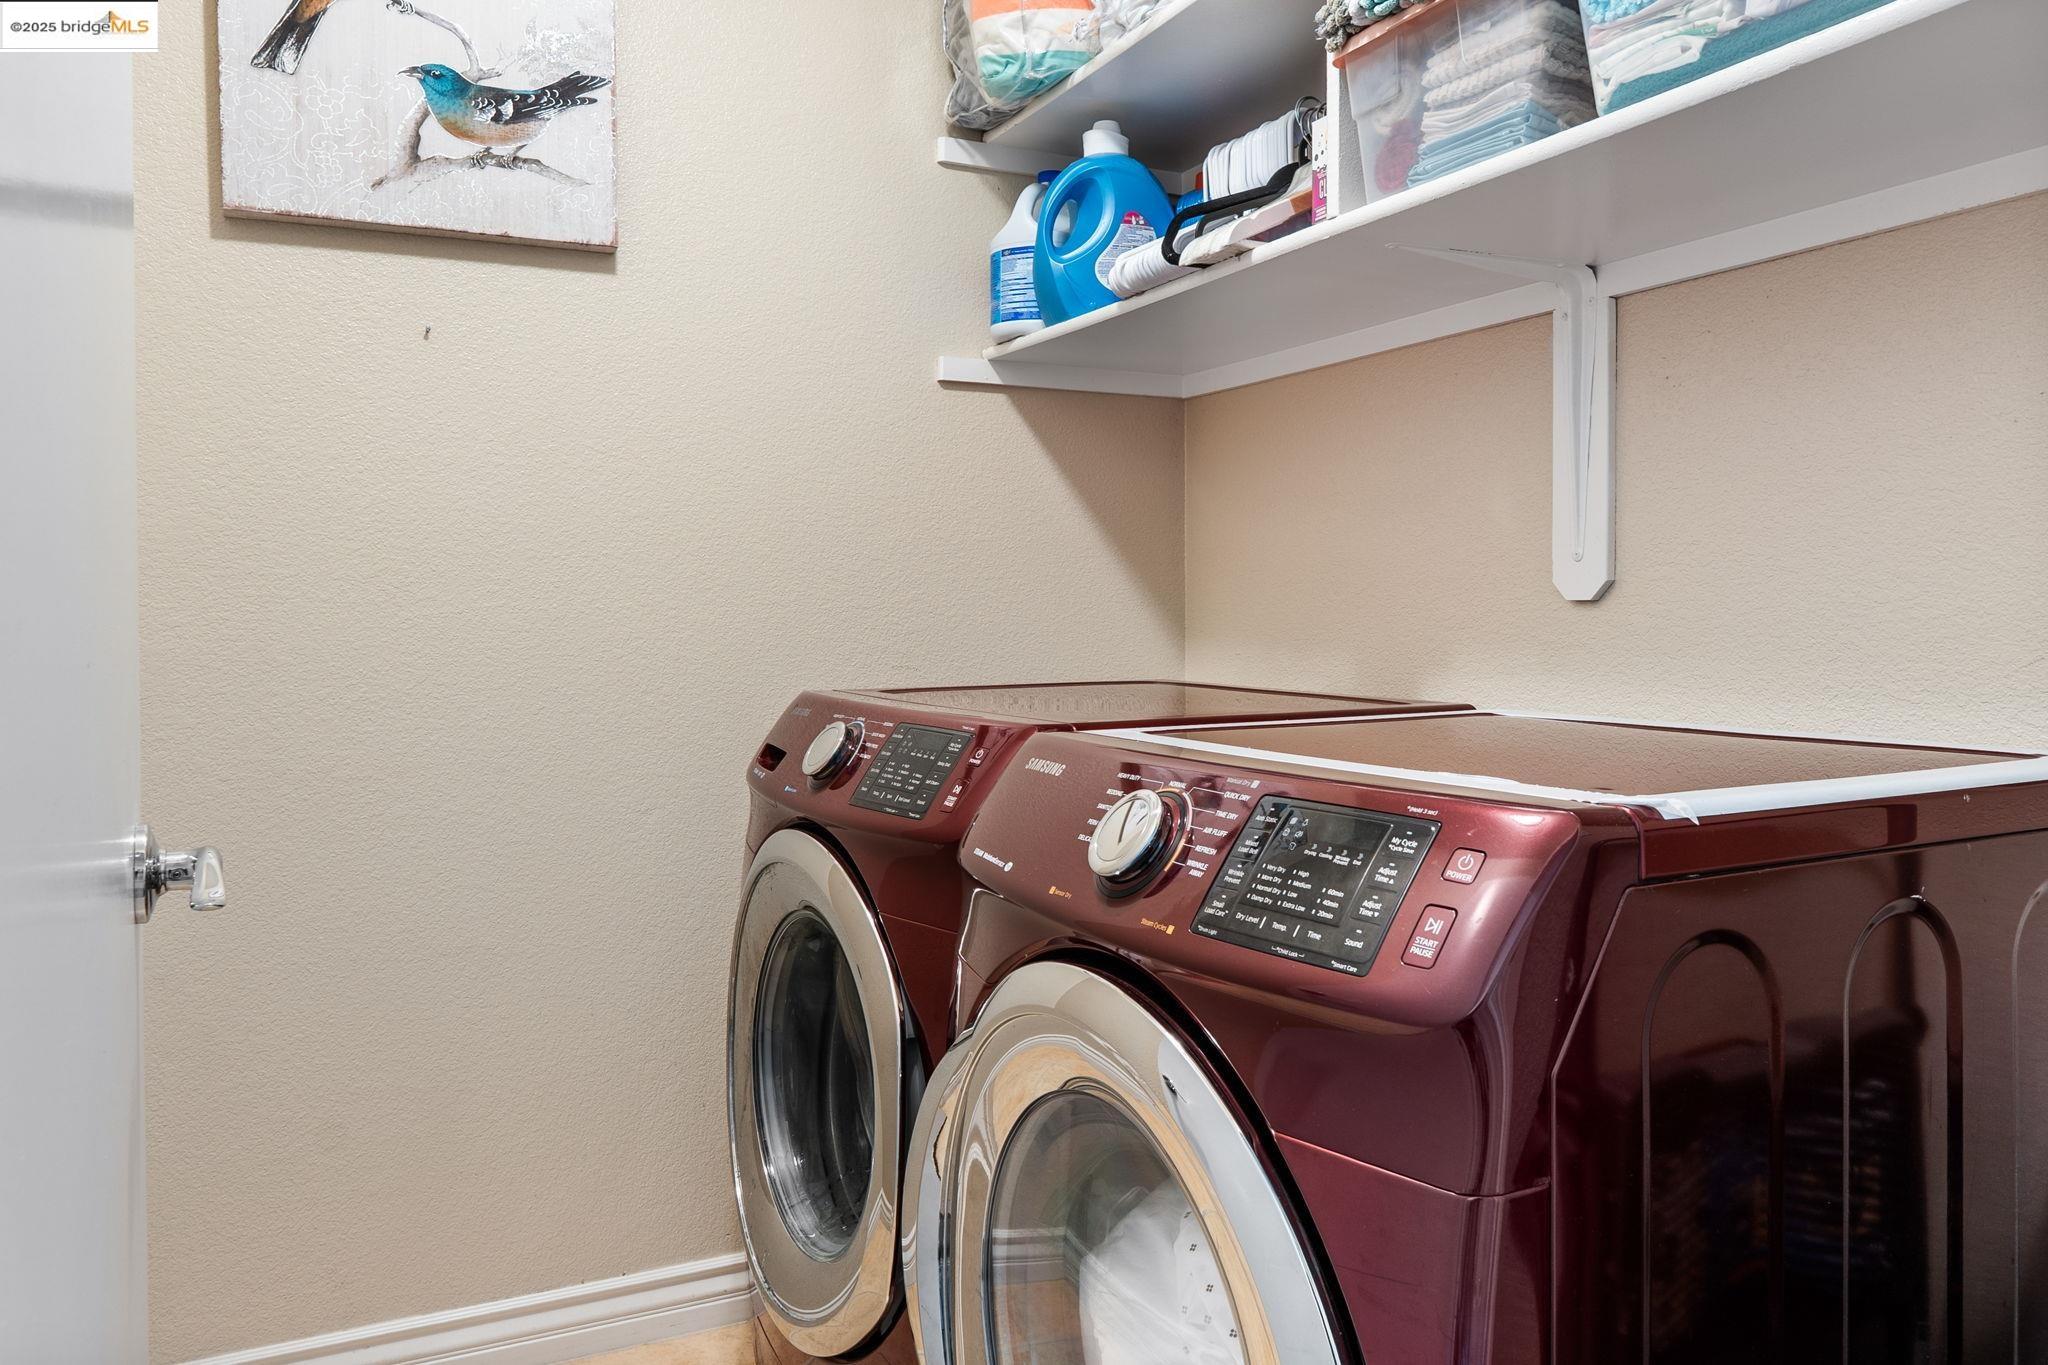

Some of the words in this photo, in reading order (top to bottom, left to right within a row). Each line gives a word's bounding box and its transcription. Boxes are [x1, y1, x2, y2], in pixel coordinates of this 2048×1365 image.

[1025, 758, 1066, 776] SAMSUNG
[1168, 780, 1187, 789] NORMAL
[1224, 791, 1240, 800] QUICK
[1215, 810, 1227, 818] TIME
[1265, 815, 1278, 824] Static
[1212, 829, 1228, 837] FLUFF
[1391, 836, 1402, 845] My
[1401, 838, 1418, 848] Cycle
[1194, 845, 1217, 856] REFRESH
[1187, 860, 1208, 870] WRINKLE
[1266, 863, 1278, 872] Very
[1188, 868, 1205, 878] AWAY
[1378, 866, 1398, 876] Adjust
[1446, 870, 1472, 881] POWER
[1224, 875, 1241, 884] Prevent
[1375, 874, 1389, 883] Time
[1256, 884, 1272, 892] Normal
[1292, 880, 1312, 890] Medium
[1327, 888, 1344, 898] 60min
[1250, 894, 1264, 903] Damp
[1264, 897, 1273, 905] Dry
[1322, 899, 1339, 908] 40min
[1282, 901, 1295, 909] Extra
[1362, 900, 1382, 910] Adjust
[1204, 906, 1216, 915] Load
[1316, 910, 1334, 920] 20min
[1359, 908, 1374, 917] Time
[1236, 912, 1246, 920] Dry
[1245, 914, 1260, 924] Level
[1140, 918, 1154, 926] Steam
[1154, 922, 1167, 932] Cycles
[1272, 921, 1287, 932] Temp.
[1307, 930, 1322, 940] Time
[1344, 938, 1364, 949] Sound
[1414, 936, 1439, 948] START
[1409, 946, 1434, 958] PAUSE
